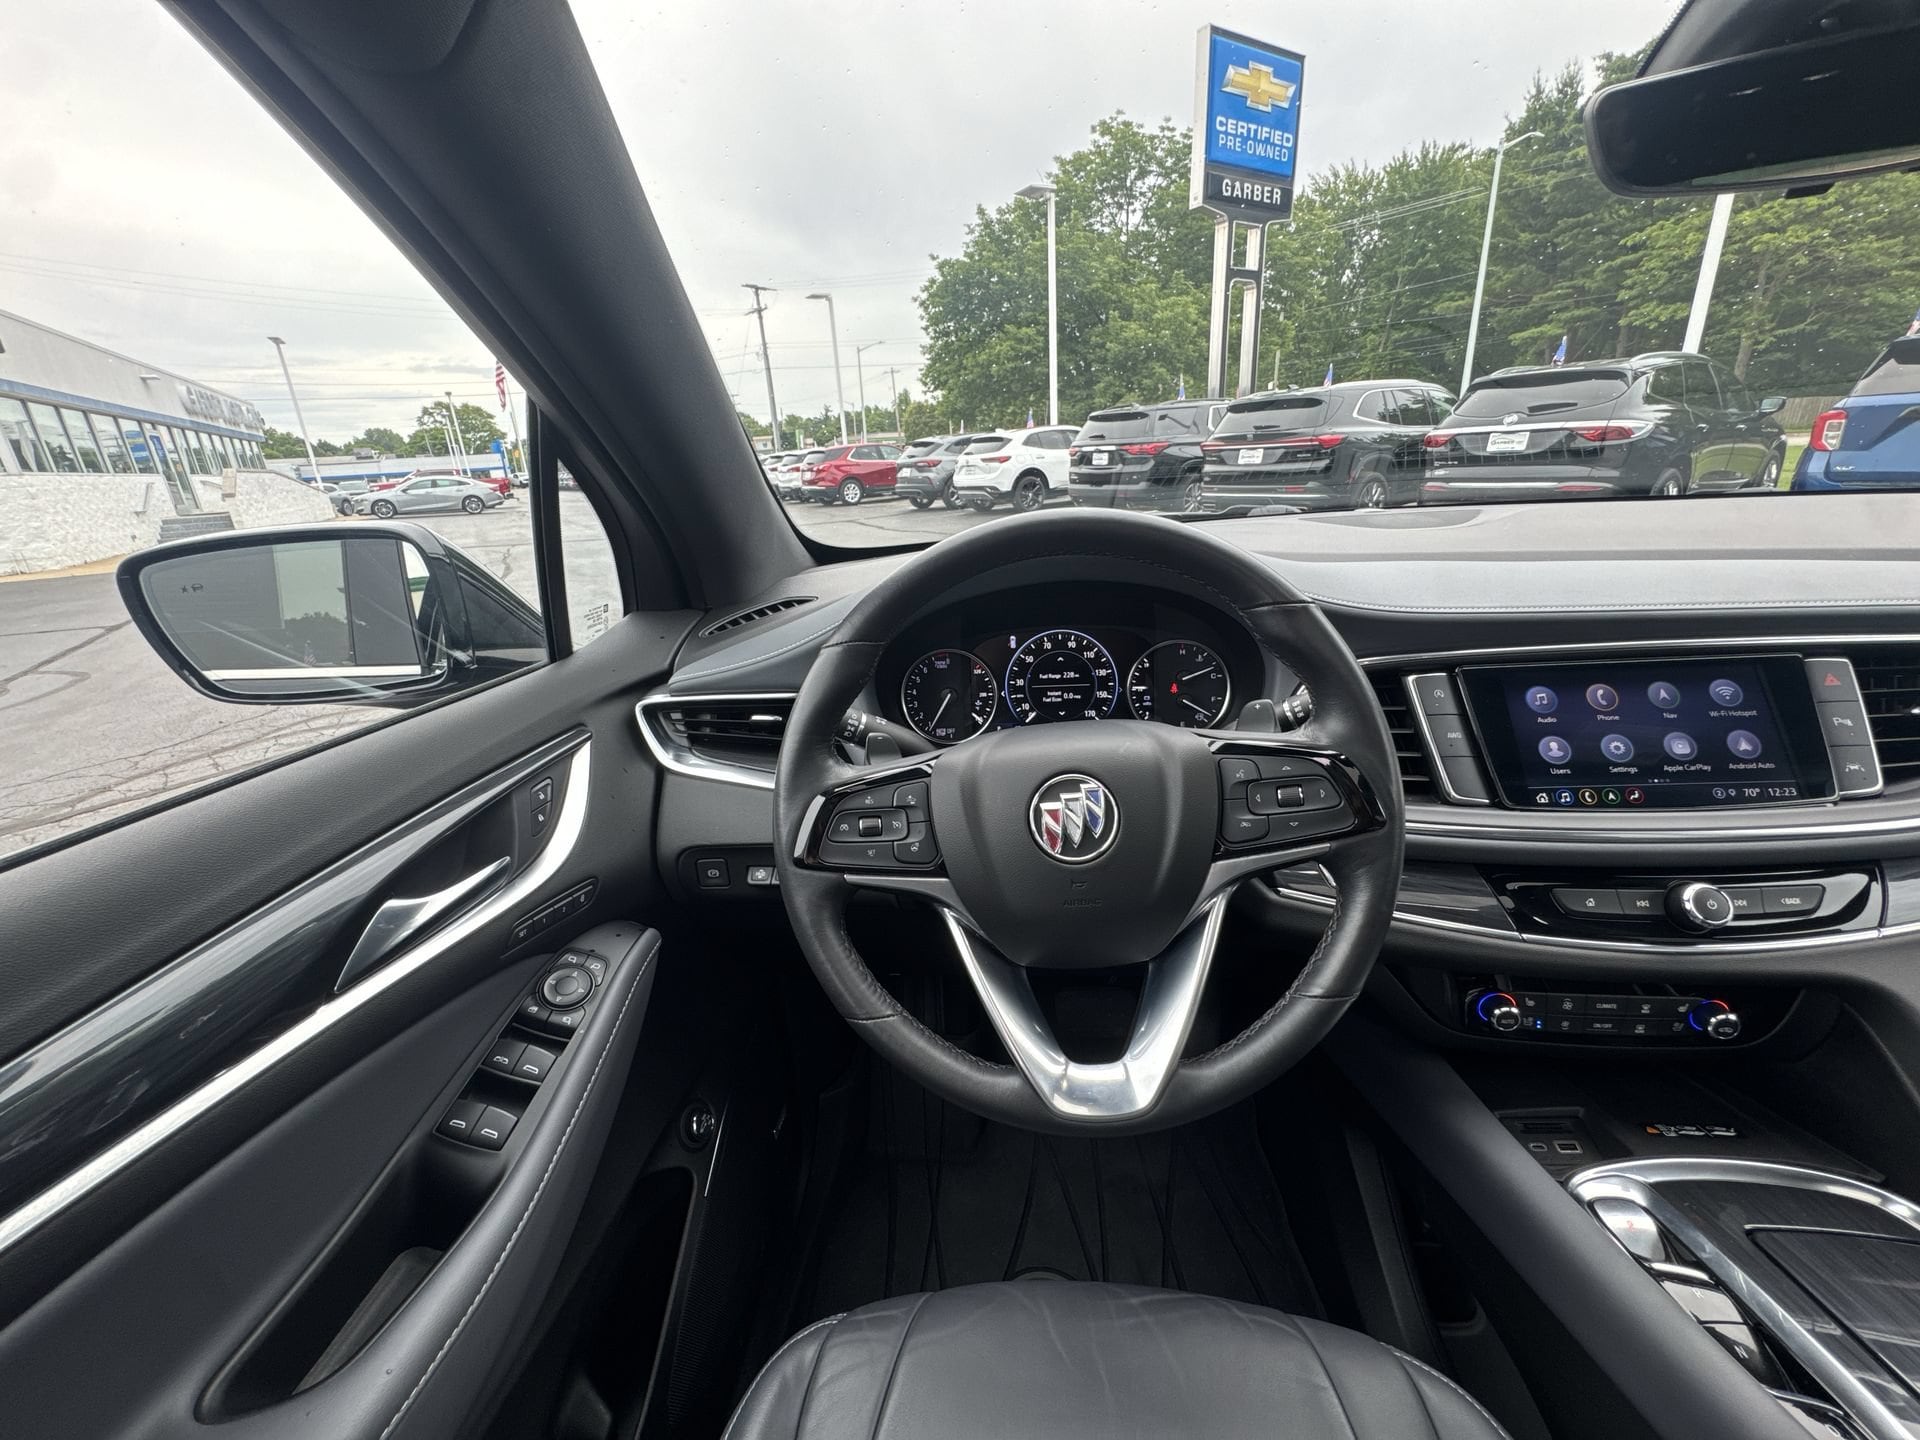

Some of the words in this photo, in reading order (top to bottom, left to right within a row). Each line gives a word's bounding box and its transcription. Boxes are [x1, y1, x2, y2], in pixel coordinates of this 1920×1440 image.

[1215, 116, 1293, 147] CERTIFIED
[1218, 134, 1289, 162] PRE-OWNED
[1222, 178, 1281, 205] GARBER
[1067, 641, 1076, 649] 90
[1025, 655, 1034, 663] 50
[1083, 651, 1095, 659] 110
[1015, 678, 1024, 686] 30
[1708, 710, 1728, 718] Wi-Fi
[1729, 709, 1758, 718] Hotspot
[1537, 716, 1558, 724] Audio
[1608, 765, 1638, 774] Settings
[1663, 764, 1683, 772] Apple
[1684, 763, 1712, 772] CarPlay
[1728, 762, 1757, 770] Android
[1550, 767, 1572, 775] Users
[1742, 788, 1761, 797] 70°
[1767, 787, 1797, 797] 12:23
[1784, 897, 1801, 905] BACK
[1733, 1344, 1749, 1359] N
